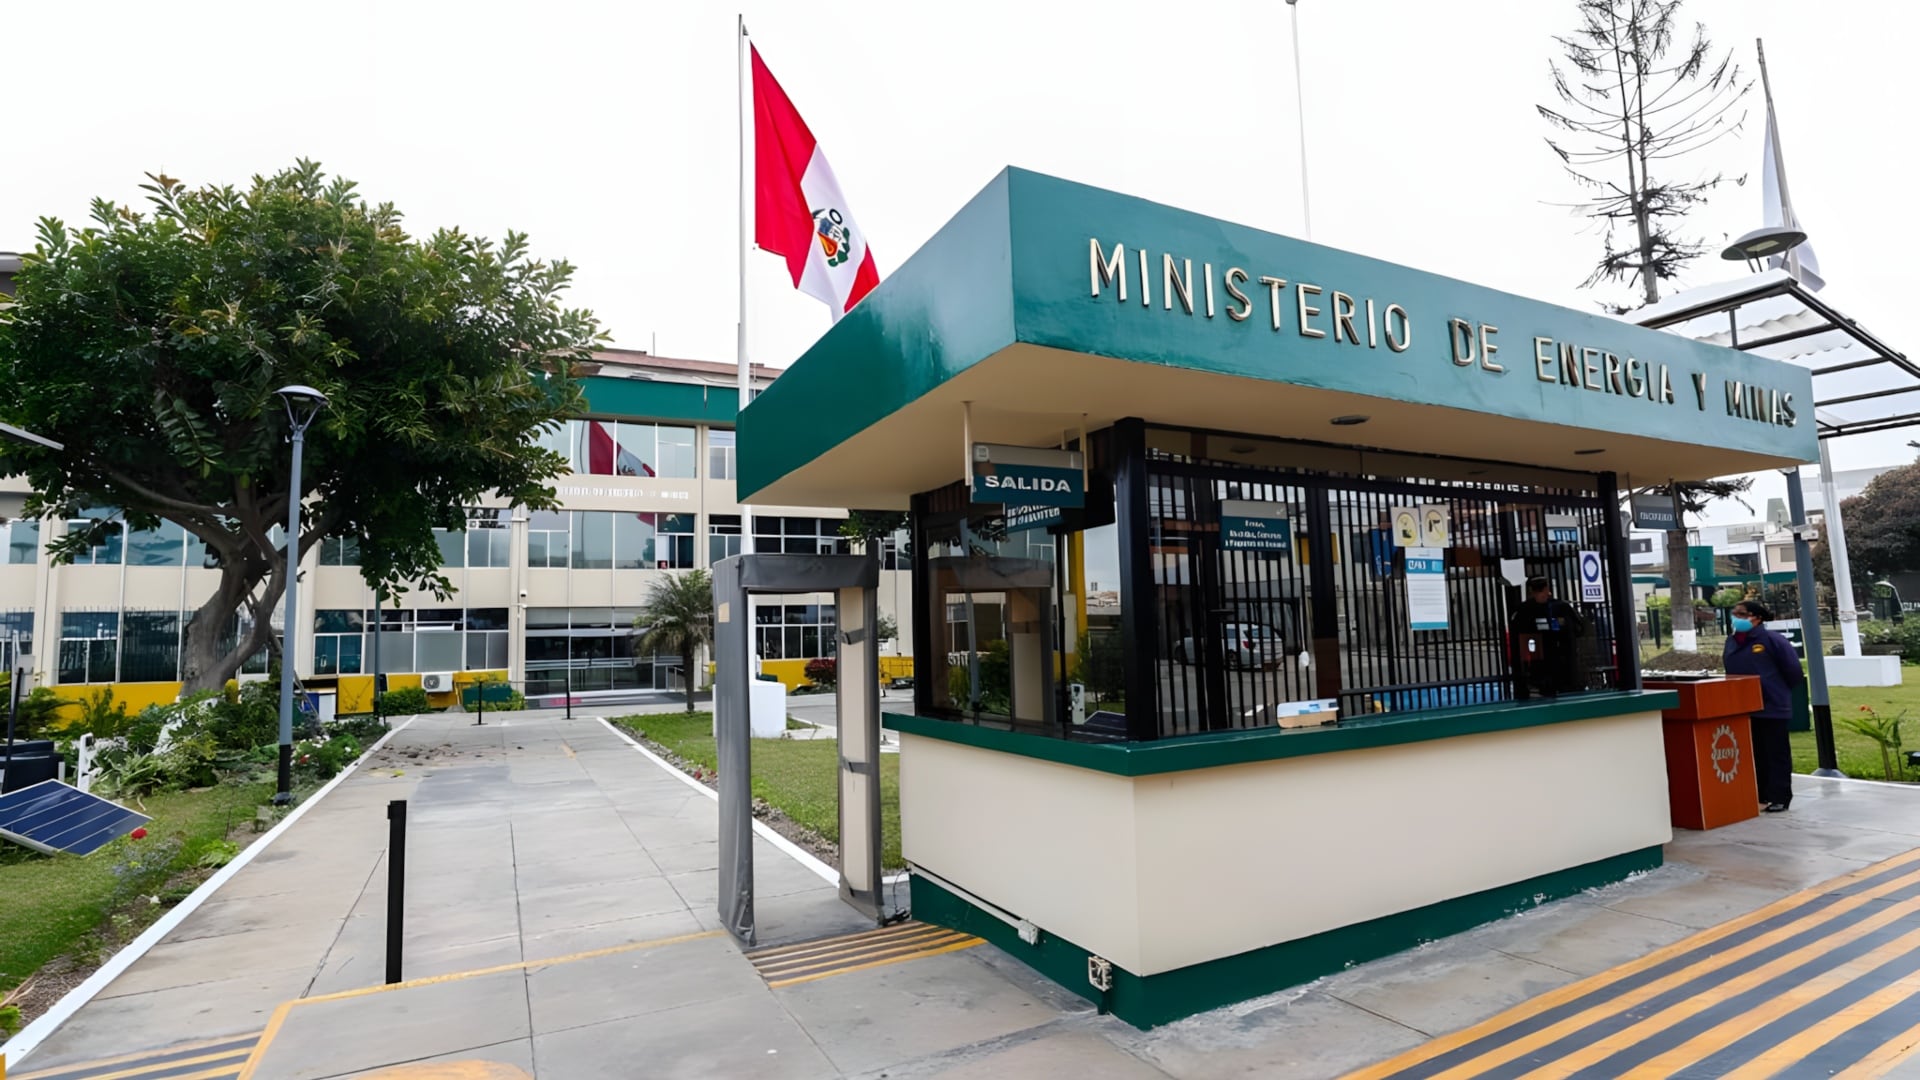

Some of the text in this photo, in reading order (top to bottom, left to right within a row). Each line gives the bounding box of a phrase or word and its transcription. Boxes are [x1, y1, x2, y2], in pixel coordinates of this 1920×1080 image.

[1090, 238, 1798, 428] MINISTERIO DE ENERGIA Y MINAS
[984, 475, 1072, 493] SALIDA
